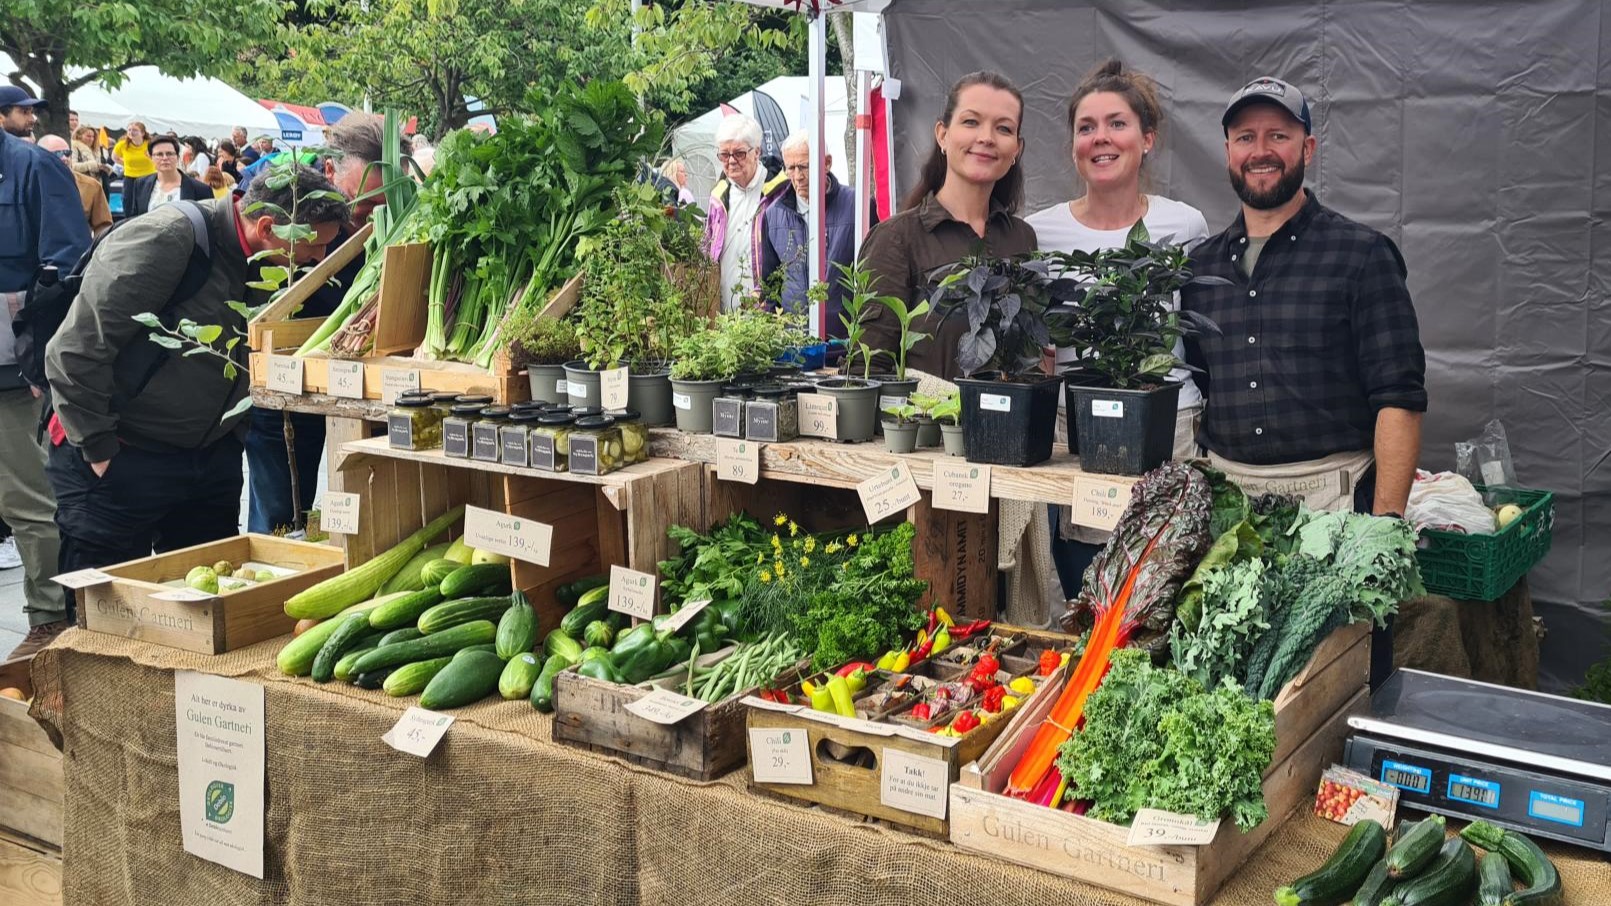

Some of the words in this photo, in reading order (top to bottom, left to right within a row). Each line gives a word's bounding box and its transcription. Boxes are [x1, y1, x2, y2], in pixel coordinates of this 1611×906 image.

[97, 598, 134, 618] Gulen
[191, 693, 200, 704] Alt
[201, 695, 211, 706] her
[211, 699, 218, 707] er
[219, 701, 237, 712] dyrka
[238, 705, 246, 713] av
[186, 708, 212, 726] Gulen
[214, 715, 252, 735] Gartneri
[766, 736, 782, 745] Chili
[904, 765, 925, 778] Takk!
[889, 775, 899, 783] For
[915, 781, 930, 791] ikkje
[889, 784, 897, 792] på
[898, 786, 913, 796] andre
[982, 814, 1049, 851] Gulen
[1063, 837, 1166, 883] Gartneri
